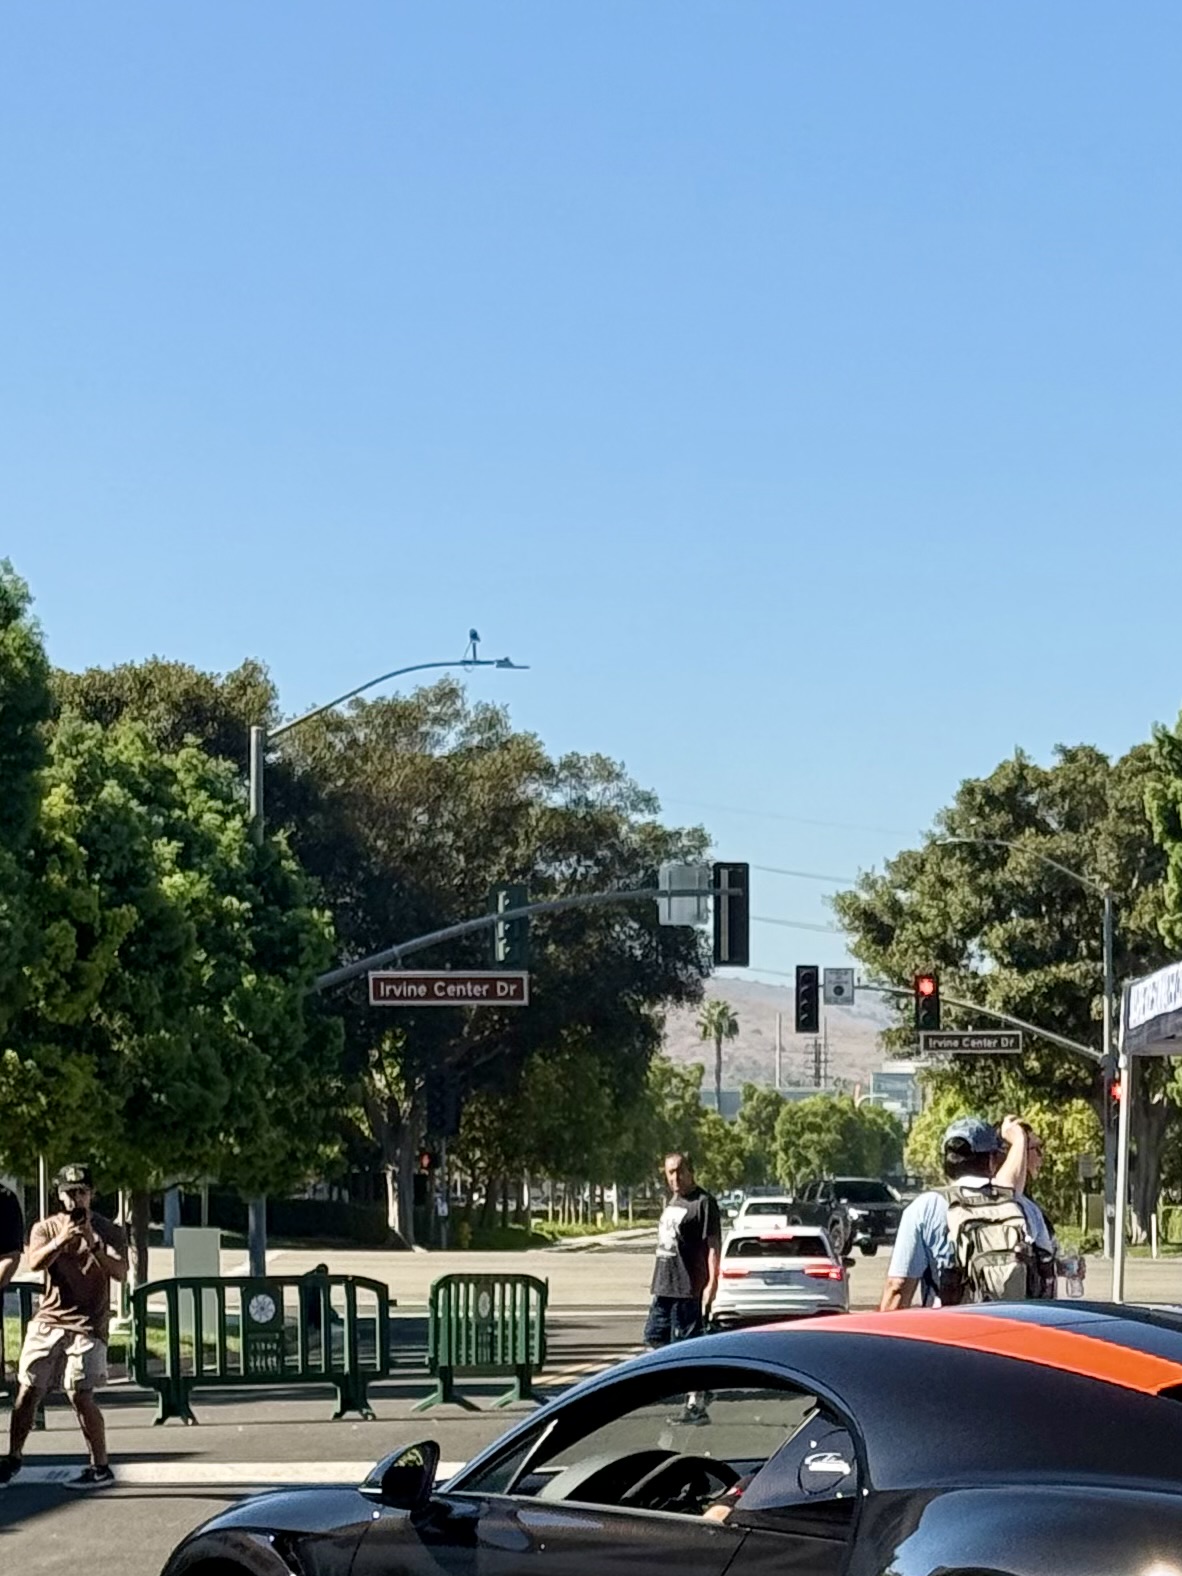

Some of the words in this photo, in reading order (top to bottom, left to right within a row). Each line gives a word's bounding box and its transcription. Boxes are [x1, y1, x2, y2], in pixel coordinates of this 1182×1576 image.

[379, 981, 427, 997] Irvine
[433, 981, 489, 997] Center
[496, 981, 517, 997] Dr
[928, 1037, 959, 1049] Irvine
[962, 1037, 998, 1049] Center
[1001, 1037, 1015, 1048] Dr
